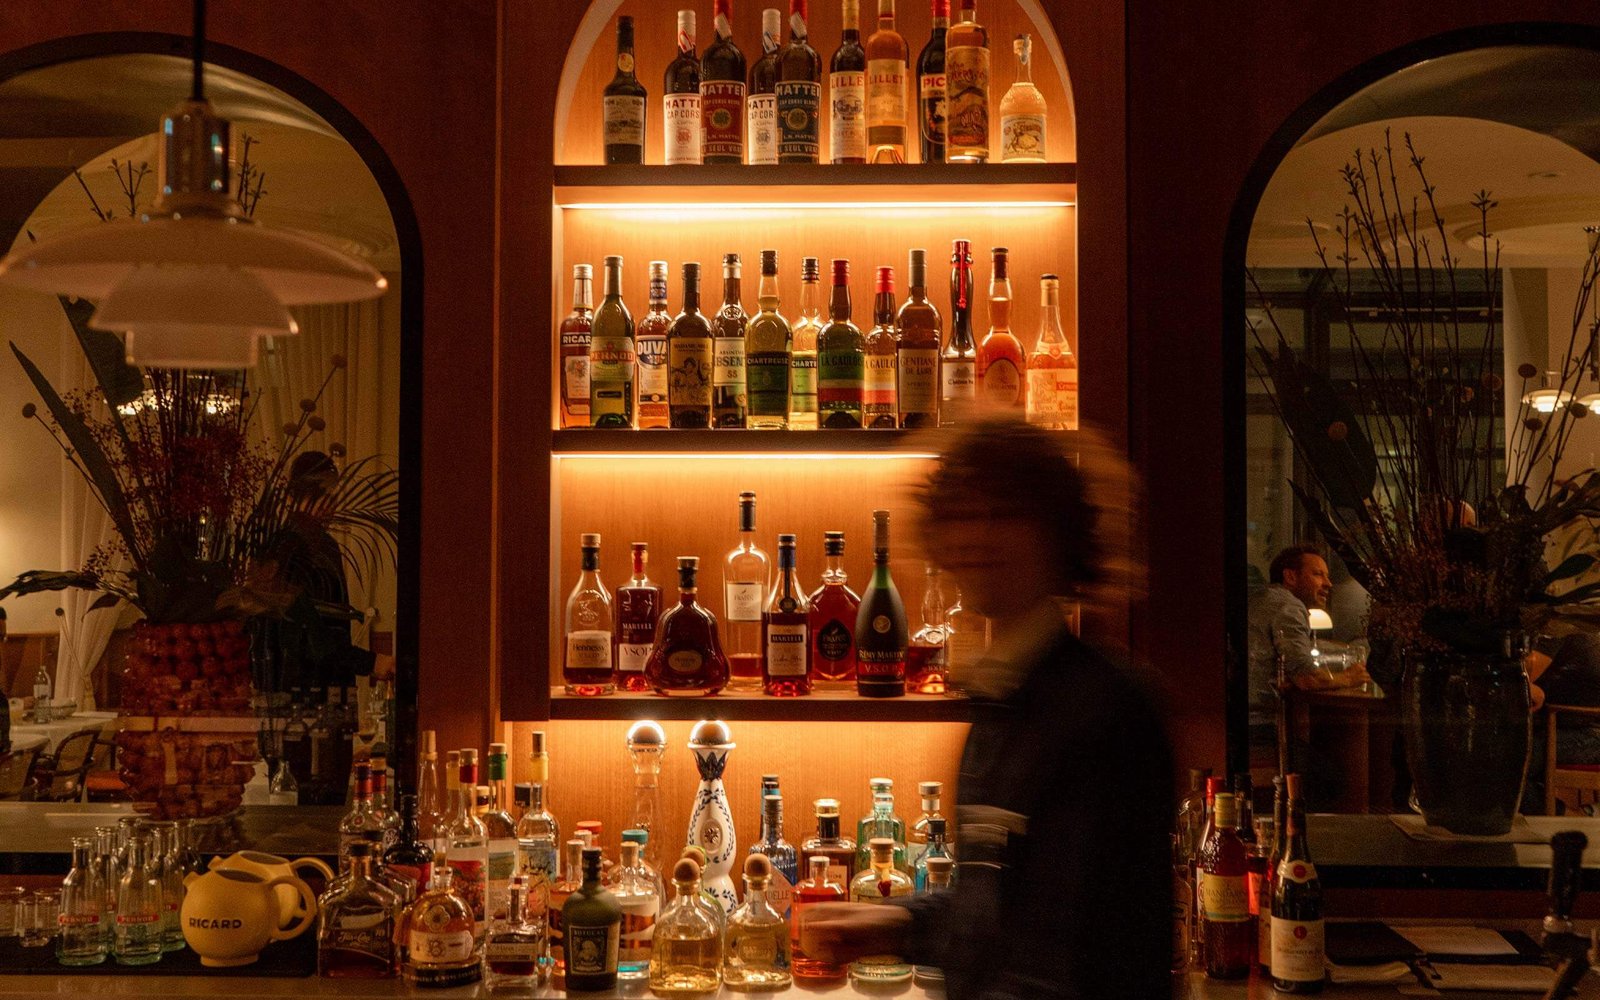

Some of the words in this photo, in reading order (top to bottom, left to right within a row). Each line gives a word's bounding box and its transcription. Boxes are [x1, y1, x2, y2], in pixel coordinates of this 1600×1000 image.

[869, 75, 903, 84] LILLET
[923, 77, 945, 87] PIC
[591, 352, 634, 361] PERNOD
[622, 622, 653, 630] MARTELL
[189, 917, 243, 929] RICARD
